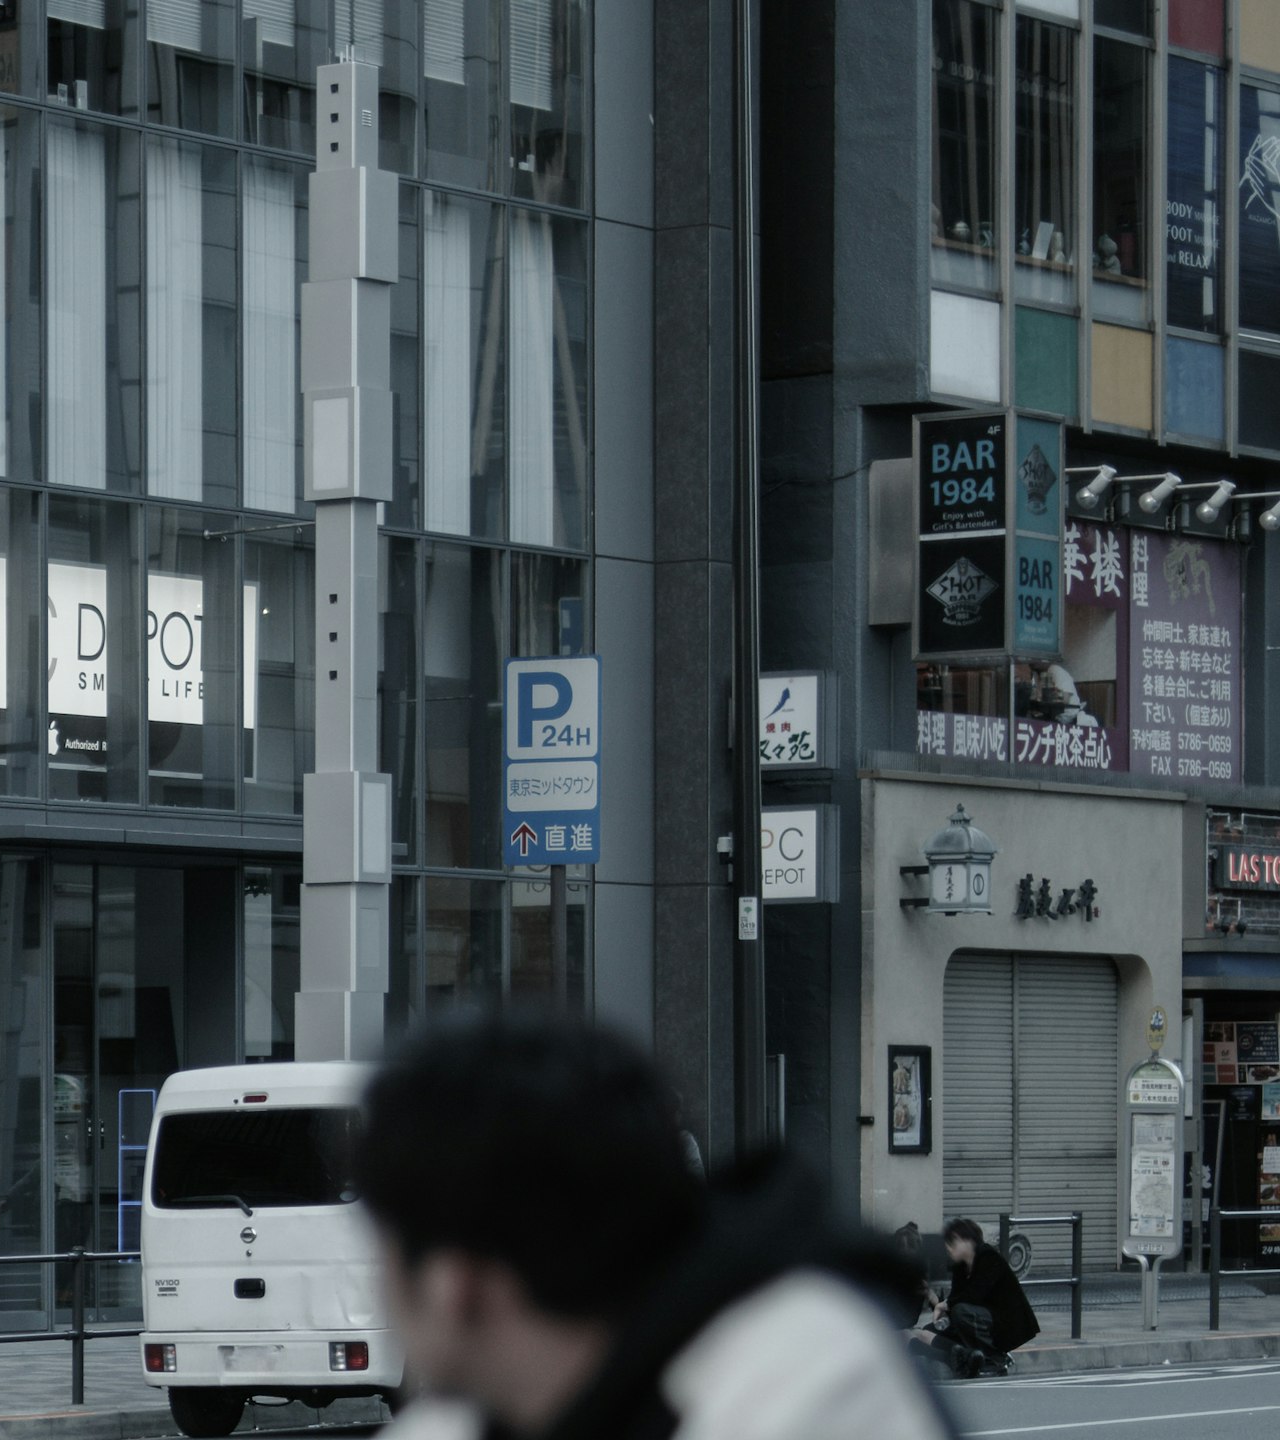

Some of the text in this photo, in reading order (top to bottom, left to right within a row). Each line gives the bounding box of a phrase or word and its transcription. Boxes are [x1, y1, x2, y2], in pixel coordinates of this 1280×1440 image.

[1178, 250, 1209, 270] RELAX
[987, 425, 1002, 436] 4F
[931, 439, 997, 474] BAR
[930, 476, 996, 506] 1984
[942, 509, 985, 521] Enjoy with
[1019, 557, 1053, 590] BAR
[1132, 534, 1150, 607] 料理
[938, 574, 987, 595] SHOT
[1017, 594, 1053, 623] 1984
[517, 671, 573, 748] P
[64, 738, 100, 751] Authorized
[541, 724, 591, 748] 24H
[917, 709, 1112, 770] 料理 風味小吃 ランチ飲茶点心
[1132, 728, 1232, 753] 予約電話 5786-0659
[1150, 755, 1232, 780] FAX 5786-0569
[509, 776, 595, 798] 東京ミッドタウン
[544, 823, 594, 852] 直進
[761, 867, 806, 886] EPOT
